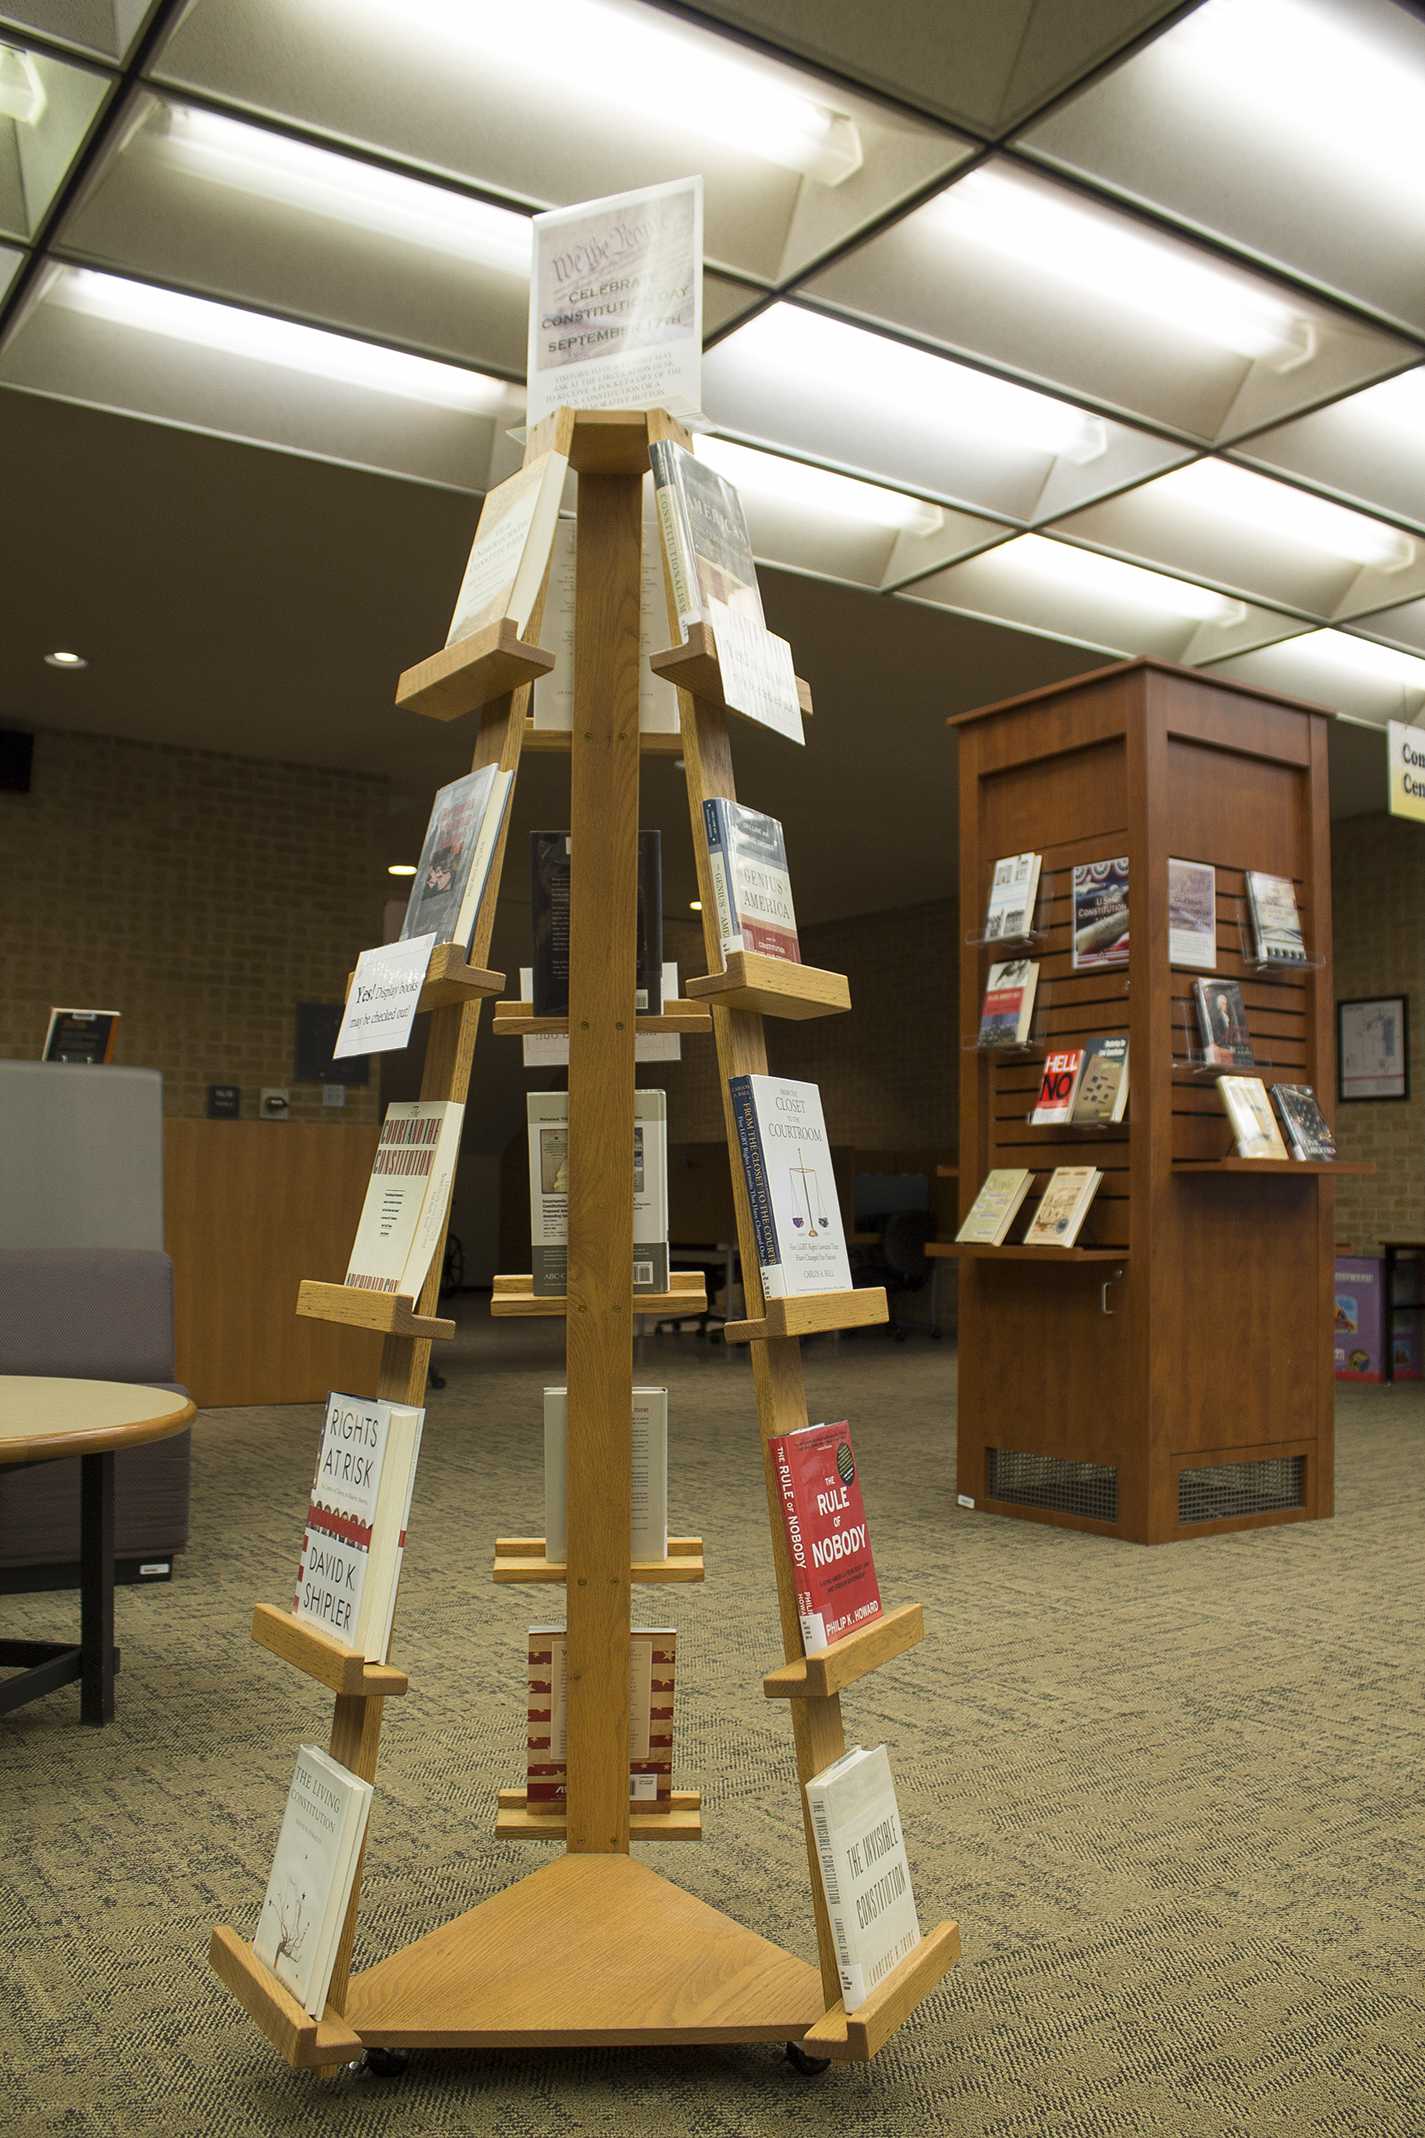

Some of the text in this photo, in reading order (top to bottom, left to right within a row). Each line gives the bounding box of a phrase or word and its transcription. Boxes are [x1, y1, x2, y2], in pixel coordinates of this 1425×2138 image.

[552, 251, 582, 283] We
[744, 867, 783, 896] GENIUS
[744, 890, 790, 919] AMERICA
[356, 984, 377, 1004] Yes!
[1045, 1053, 1078, 1073] HELL
[1040, 1071, 1073, 1101] NO
[743, 1102, 754, 1130] FROM
[776, 1096, 806, 1113] CLOSET
[381, 1119, 410, 1145] COURT
[421, 1118, 442, 1145] THE
[748, 1130, 758, 1151] THE
[768, 1122, 823, 1143] COURTROOM
[373, 1150, 435, 1177] CONSTITUTION
[752, 1151, 764, 1187] CLOSET
[760, 1204, 769, 1224] THE
[330, 1408, 379, 1448] RIGHTS
[323, 1449, 374, 1489] AT RISK
[776, 1446, 786, 1462] THE
[779, 1465, 794, 1500] RULE
[825, 1476, 836, 1486] THE
[816, 1486, 850, 1516] RULE
[833, 1516, 842, 1528] OF
[786, 1516, 808, 1569] NOBODY
[811, 1524, 867, 1568] NOBODY
[309, 1546, 355, 1592] DAVID K.
[303, 1583, 352, 1632] SHIPLER
[826, 1616, 847, 1638] PHILIP
[854, 1600, 879, 1622] HOWARD
[296, 1766, 341, 1813] THE LIVING
[290, 1789, 336, 1833] CONSTITUTION
[812, 1800, 841, 1905] THE INVISIBLE CONSTITUTION
[845, 1815, 899, 1881] THE INVISIBLE
[855, 1863, 907, 1930] CONSTITUTION
